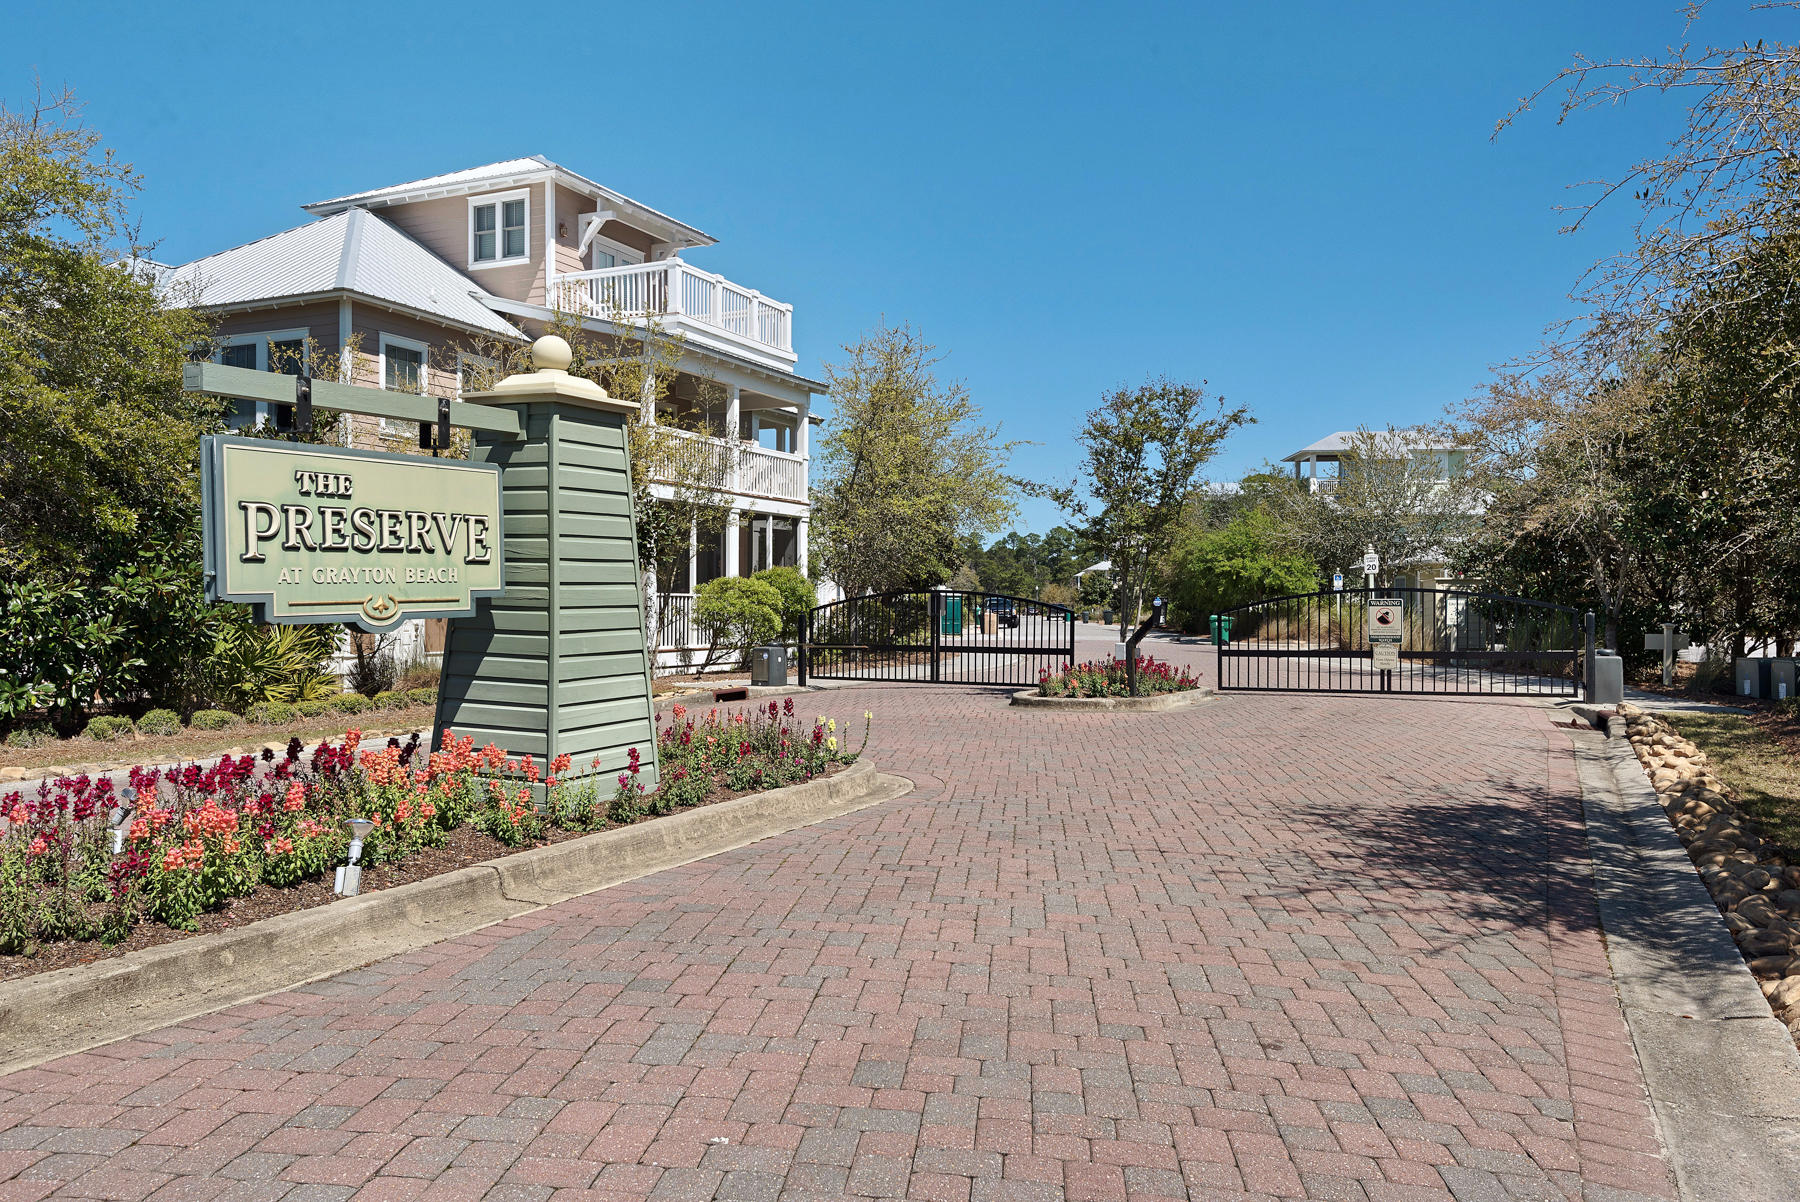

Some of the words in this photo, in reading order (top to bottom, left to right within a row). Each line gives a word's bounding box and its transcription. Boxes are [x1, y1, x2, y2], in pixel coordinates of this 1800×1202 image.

[295, 470, 353, 498] THE
[239, 501, 492, 565] PRESERVE
[278, 567, 302, 585] AT
[312, 567, 397, 585] GRAYTON
[405, 566, 459, 584] BEACH
